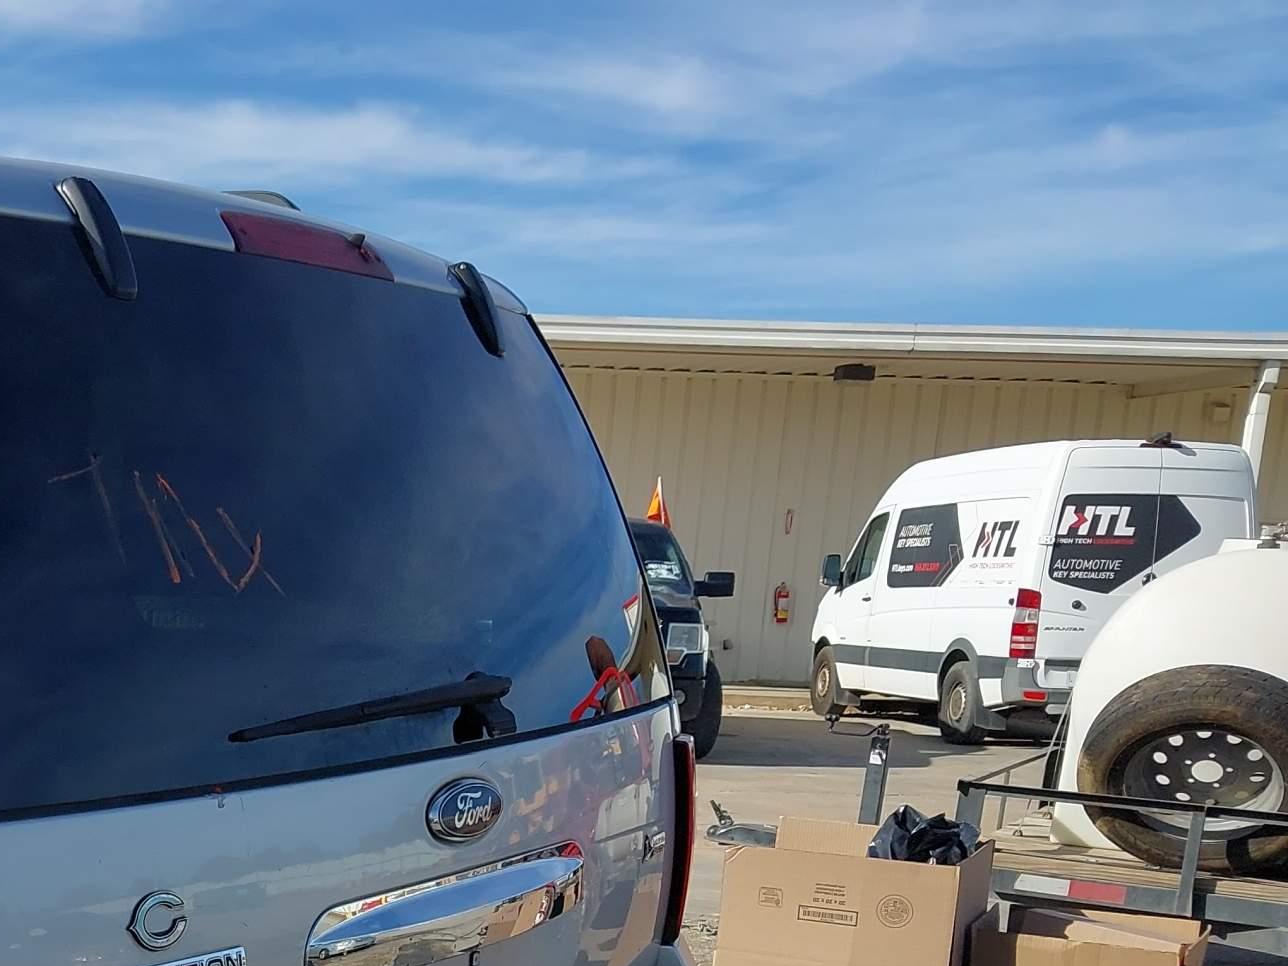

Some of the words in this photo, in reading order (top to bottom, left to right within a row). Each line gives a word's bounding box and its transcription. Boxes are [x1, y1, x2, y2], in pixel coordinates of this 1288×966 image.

[1057, 505, 1136, 536] HTL
[971, 520, 1020, 558] HTL
[1053, 559, 1123, 571] AUTOMOTIVE
[1069, 571, 1115, 579] SPECIALISTS
[455, 791, 492, 829] Ford
